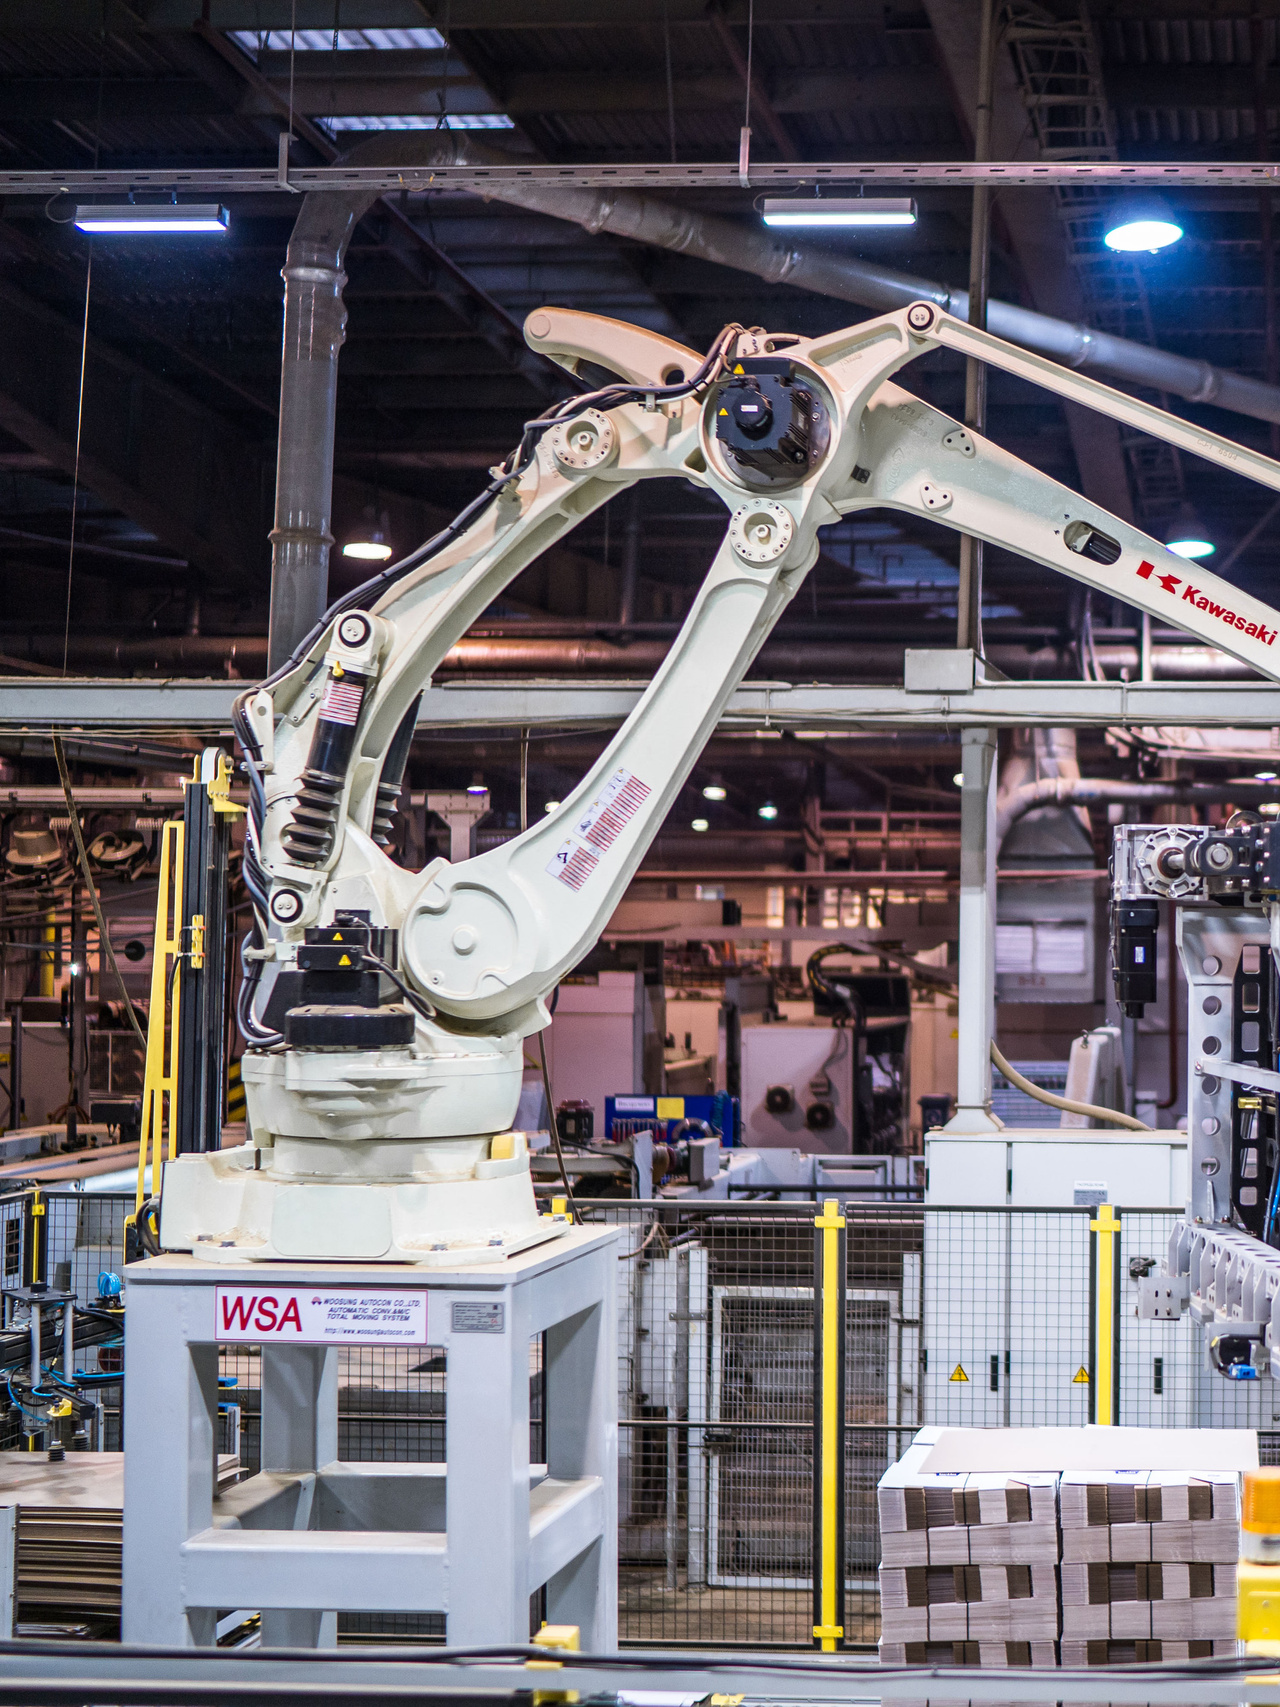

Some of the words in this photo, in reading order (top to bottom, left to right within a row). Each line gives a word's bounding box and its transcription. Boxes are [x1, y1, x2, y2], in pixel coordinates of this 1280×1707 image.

[1182, 585, 1278, 646] Kawasaki
[222, 1296, 303, 1332] WSA
[323, 1298, 358, 1306] WOOSUNG
[359, 1299, 392, 1307] AUTOCON
